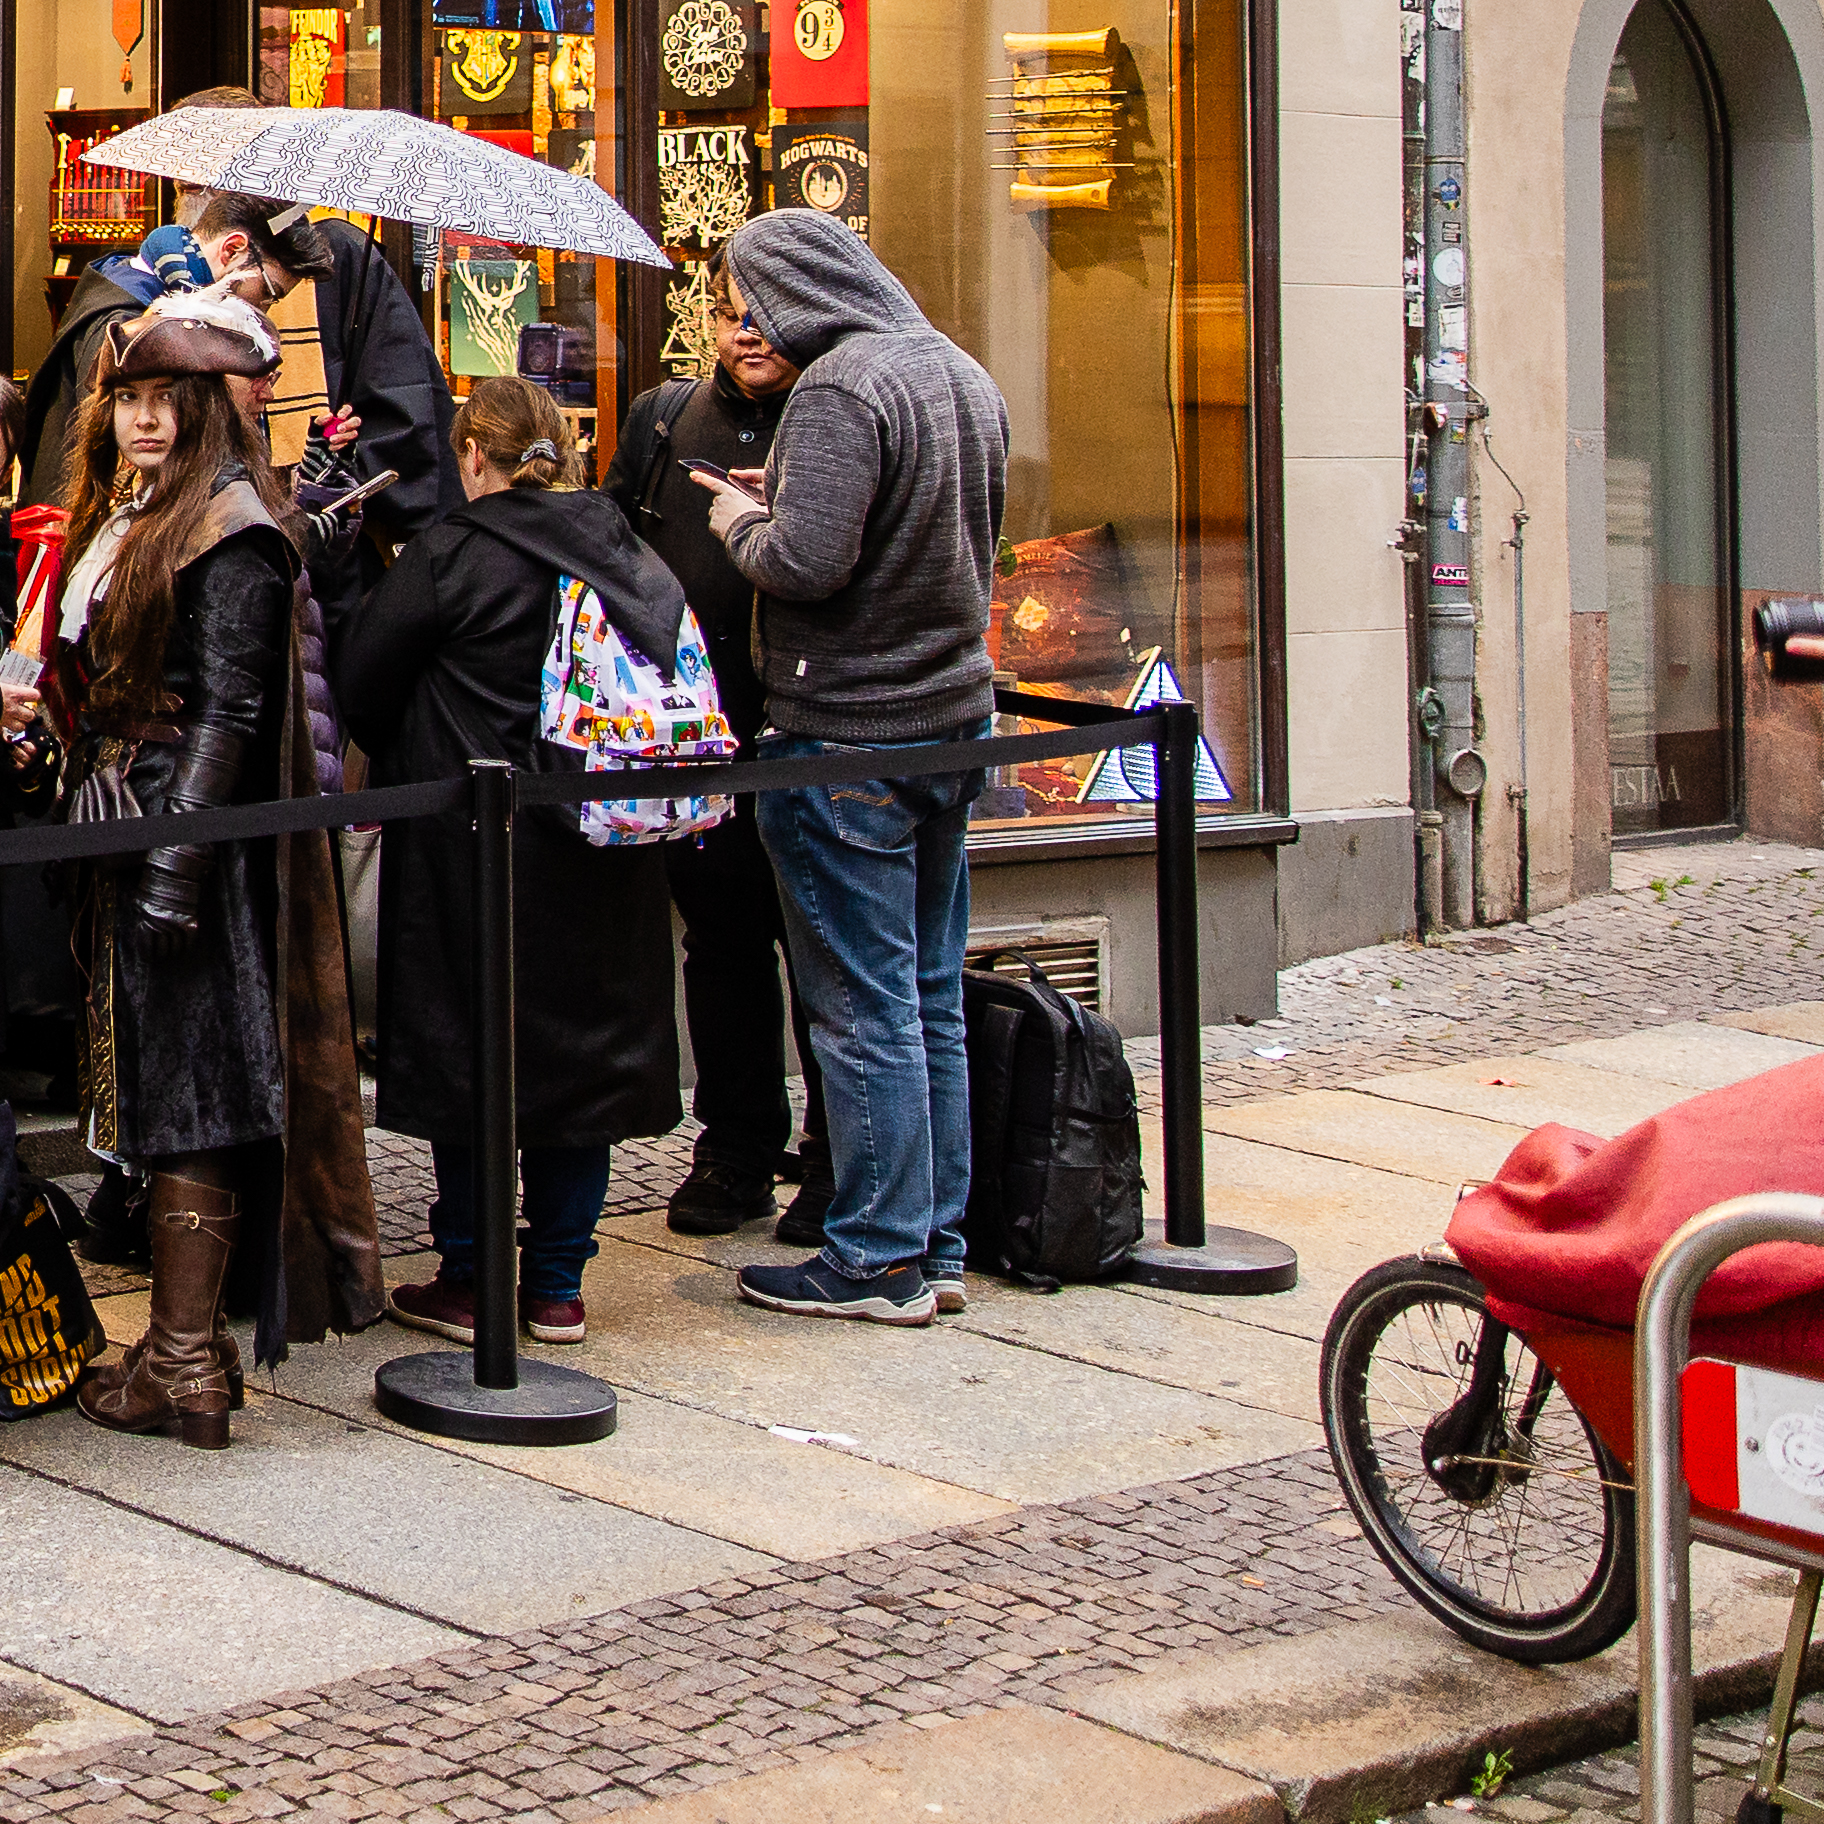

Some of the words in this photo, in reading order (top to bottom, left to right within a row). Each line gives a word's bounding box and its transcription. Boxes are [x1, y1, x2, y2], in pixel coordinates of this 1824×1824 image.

[658, 130, 750, 167] BLACK
[779, 139, 869, 170] HOGWARTS
[847, 215, 869, 232] OF
